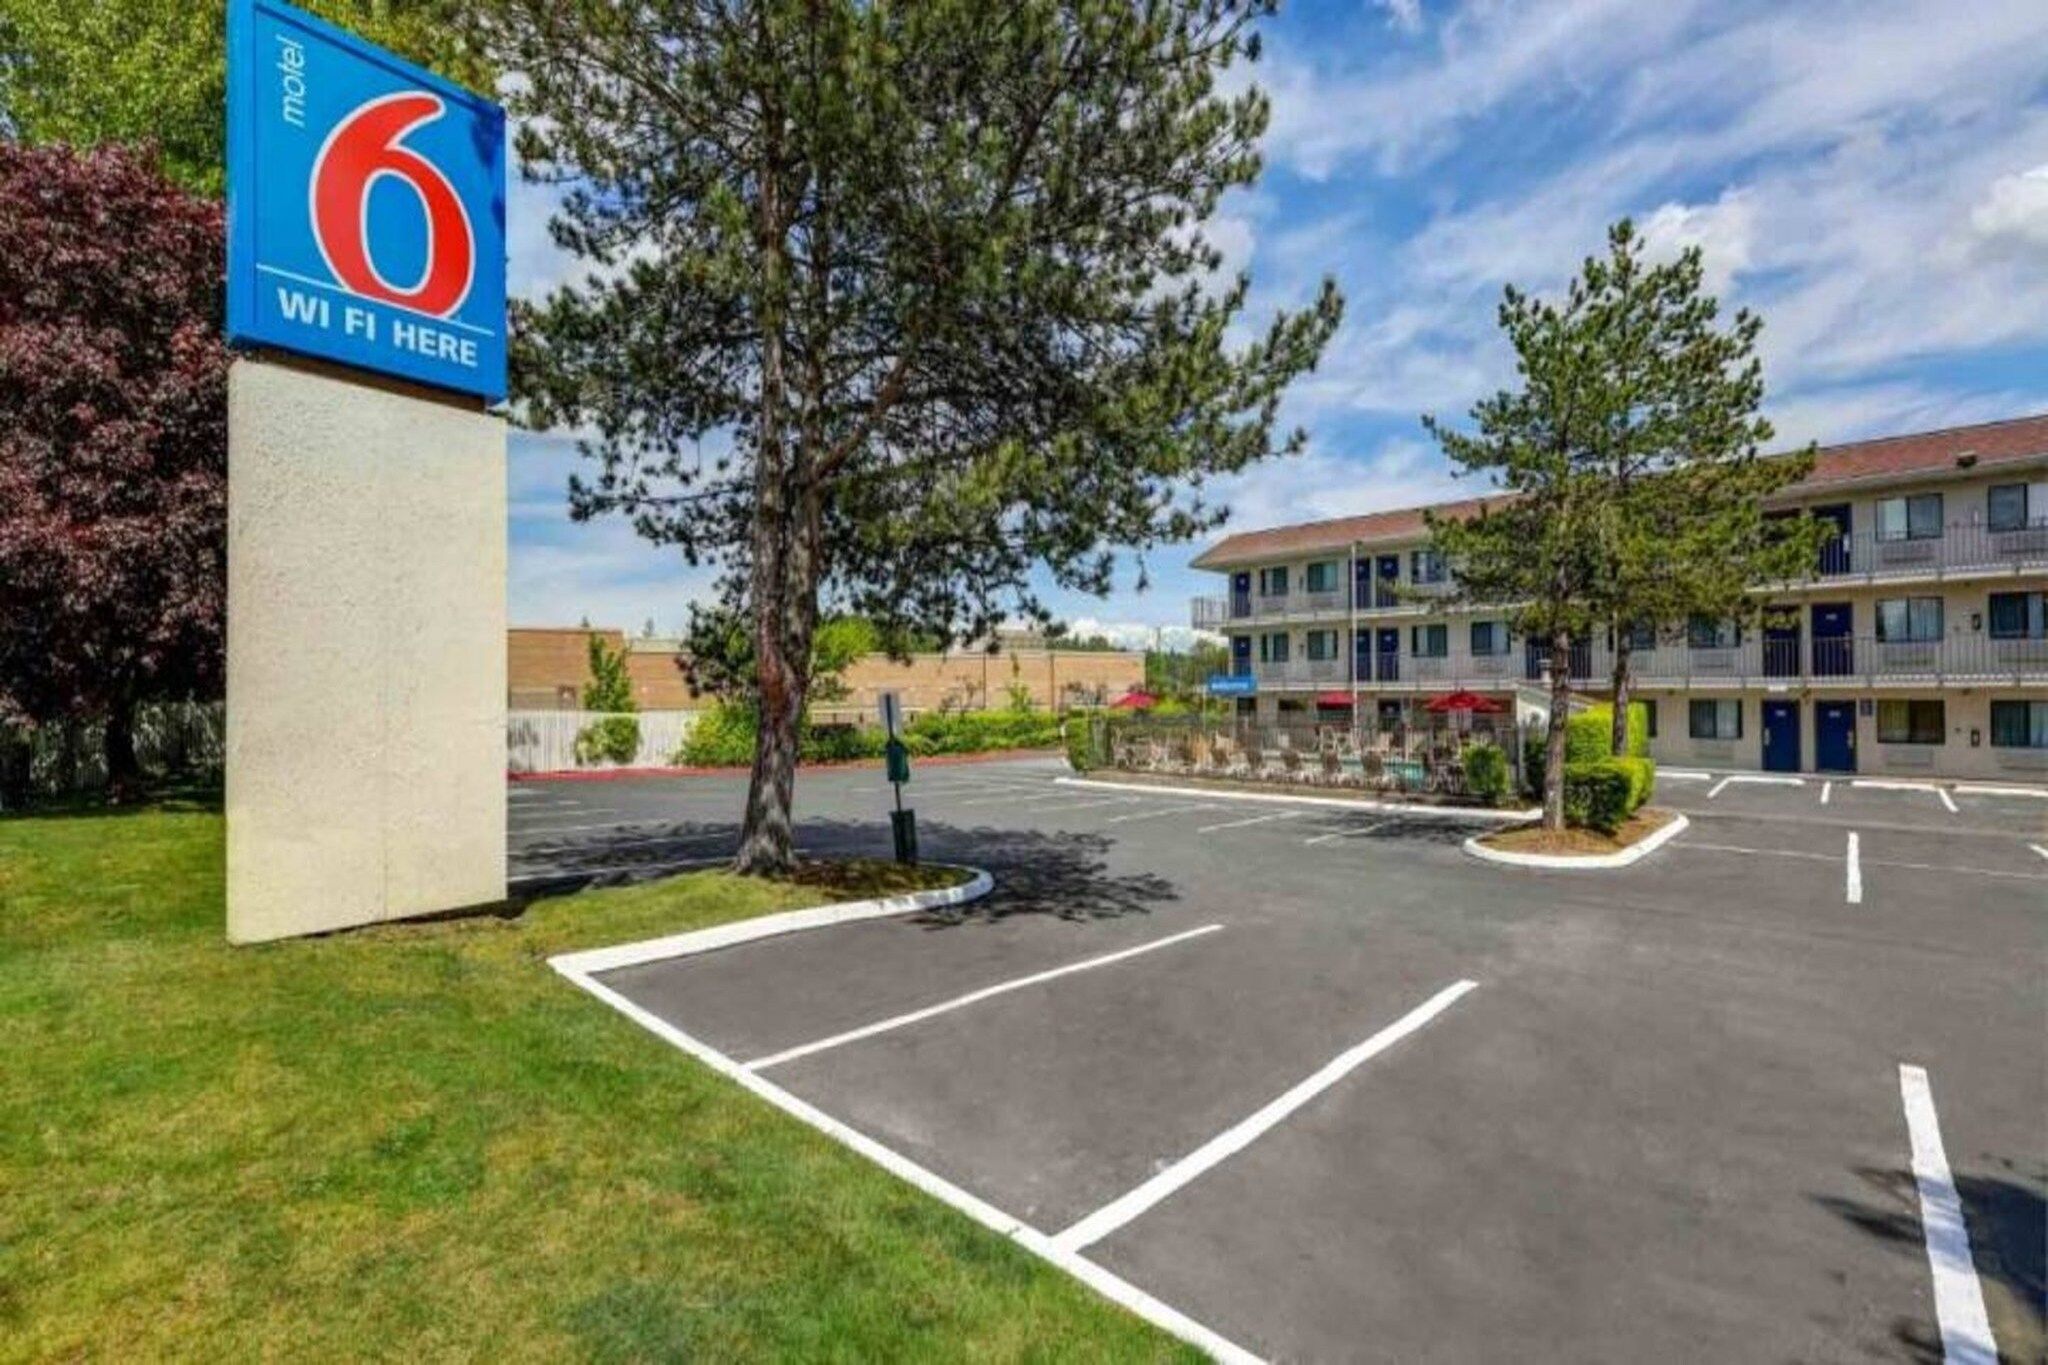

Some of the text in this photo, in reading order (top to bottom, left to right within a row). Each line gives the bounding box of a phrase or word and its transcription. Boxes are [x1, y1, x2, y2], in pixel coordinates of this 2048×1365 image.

[276, 34, 305, 127] motel
[309, 91, 475, 319] 6
[277, 287, 478, 367] WI FI HERE
